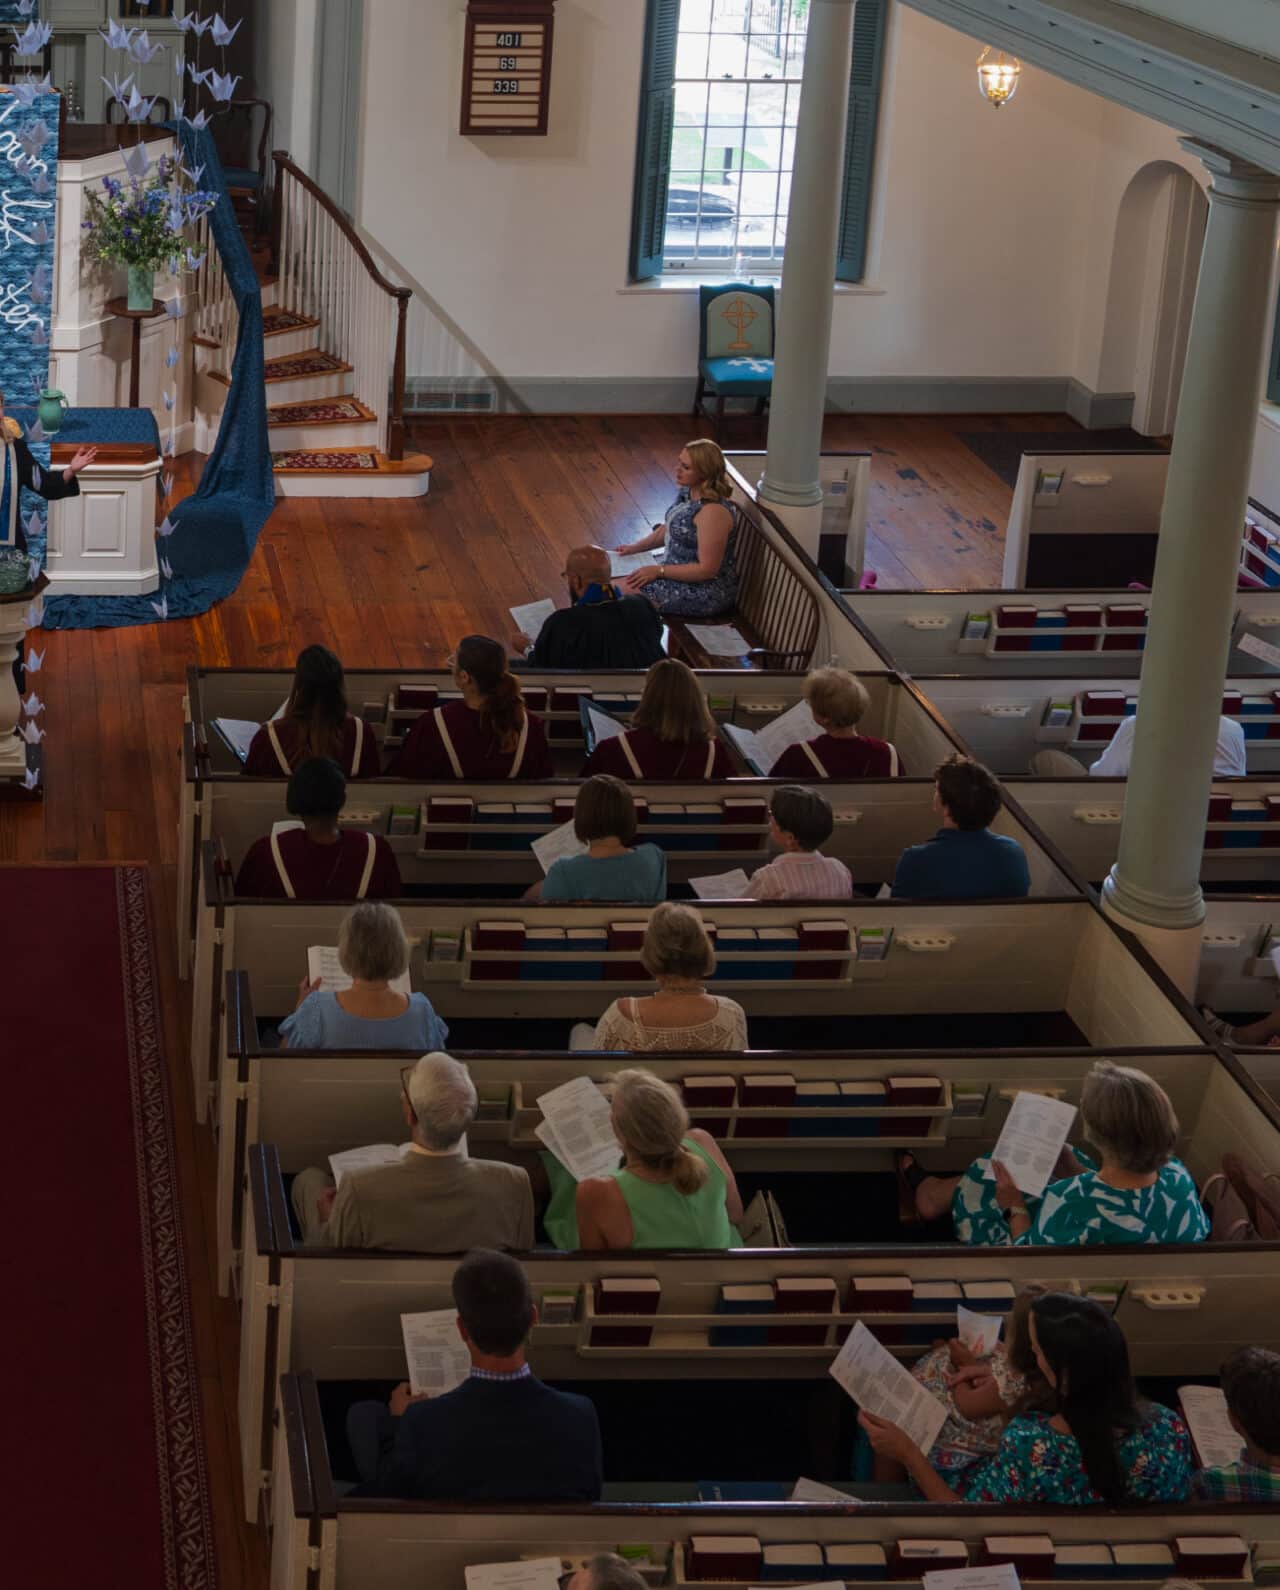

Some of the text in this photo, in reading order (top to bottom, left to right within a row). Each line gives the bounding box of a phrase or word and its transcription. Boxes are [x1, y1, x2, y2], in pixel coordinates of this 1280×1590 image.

[497, 33, 520, 47] 401
[500, 57, 516, 70] 69
[494, 80, 518, 93] 339
